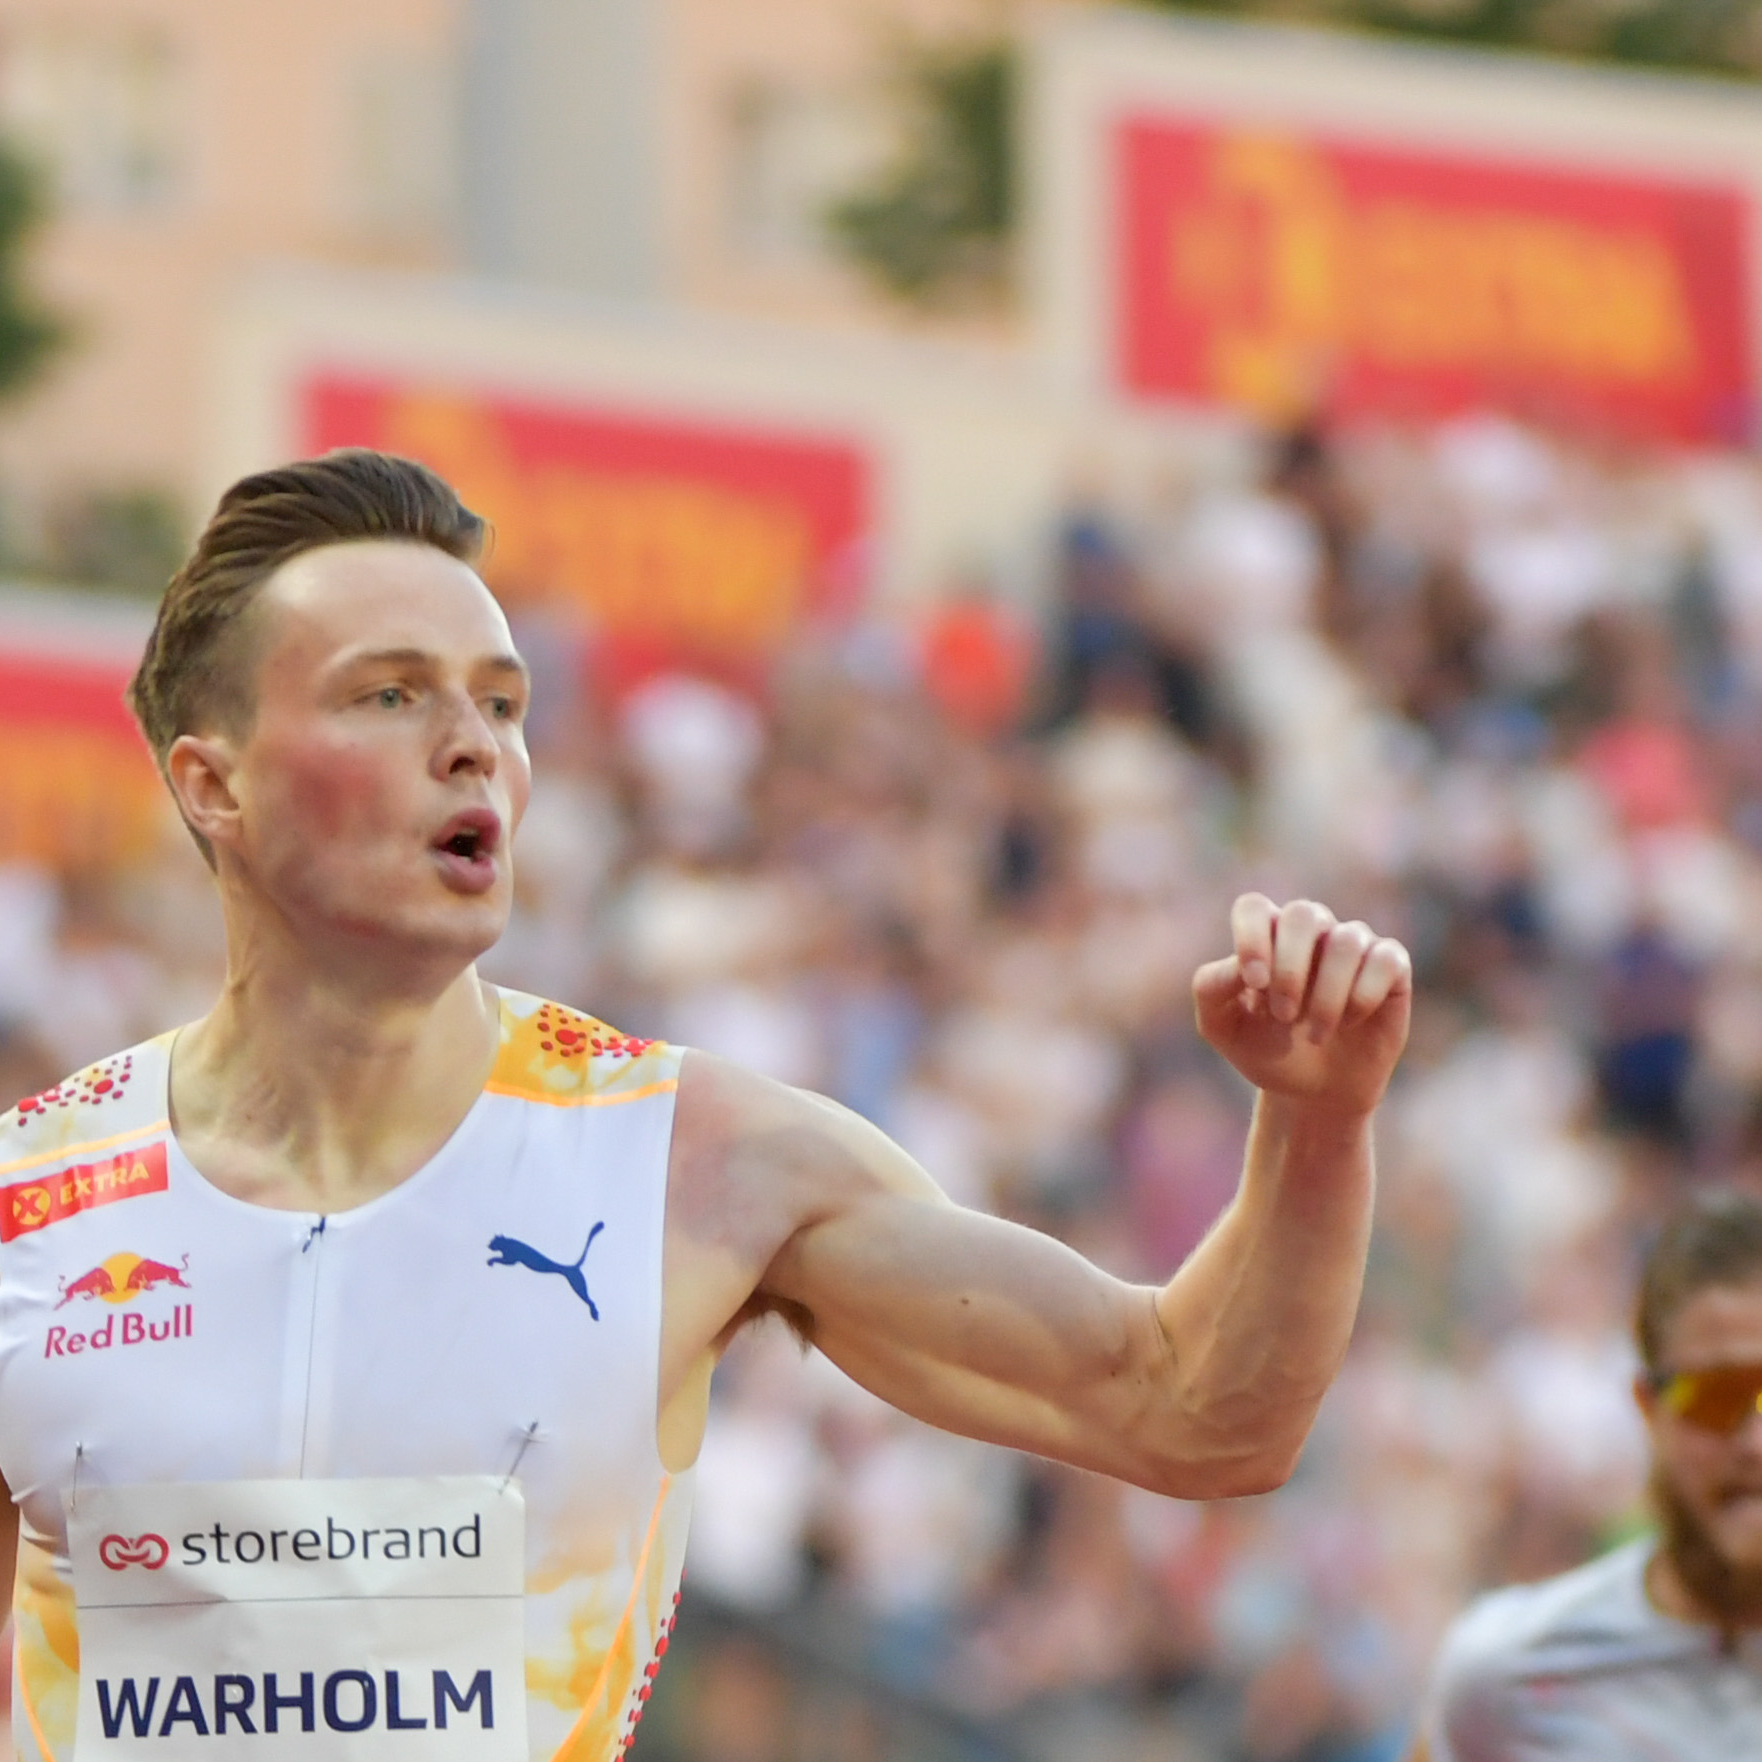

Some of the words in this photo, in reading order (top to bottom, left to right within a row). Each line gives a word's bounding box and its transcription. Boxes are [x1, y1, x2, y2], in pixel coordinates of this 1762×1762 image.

[59, 1160, 149, 1207] EXTRA
[44, 1309, 113, 1359] Red
[120, 1304, 193, 1345] Bull
[181, 1513, 482, 1566] storebrand
[95, 1668, 495, 1739] WARHOLM
